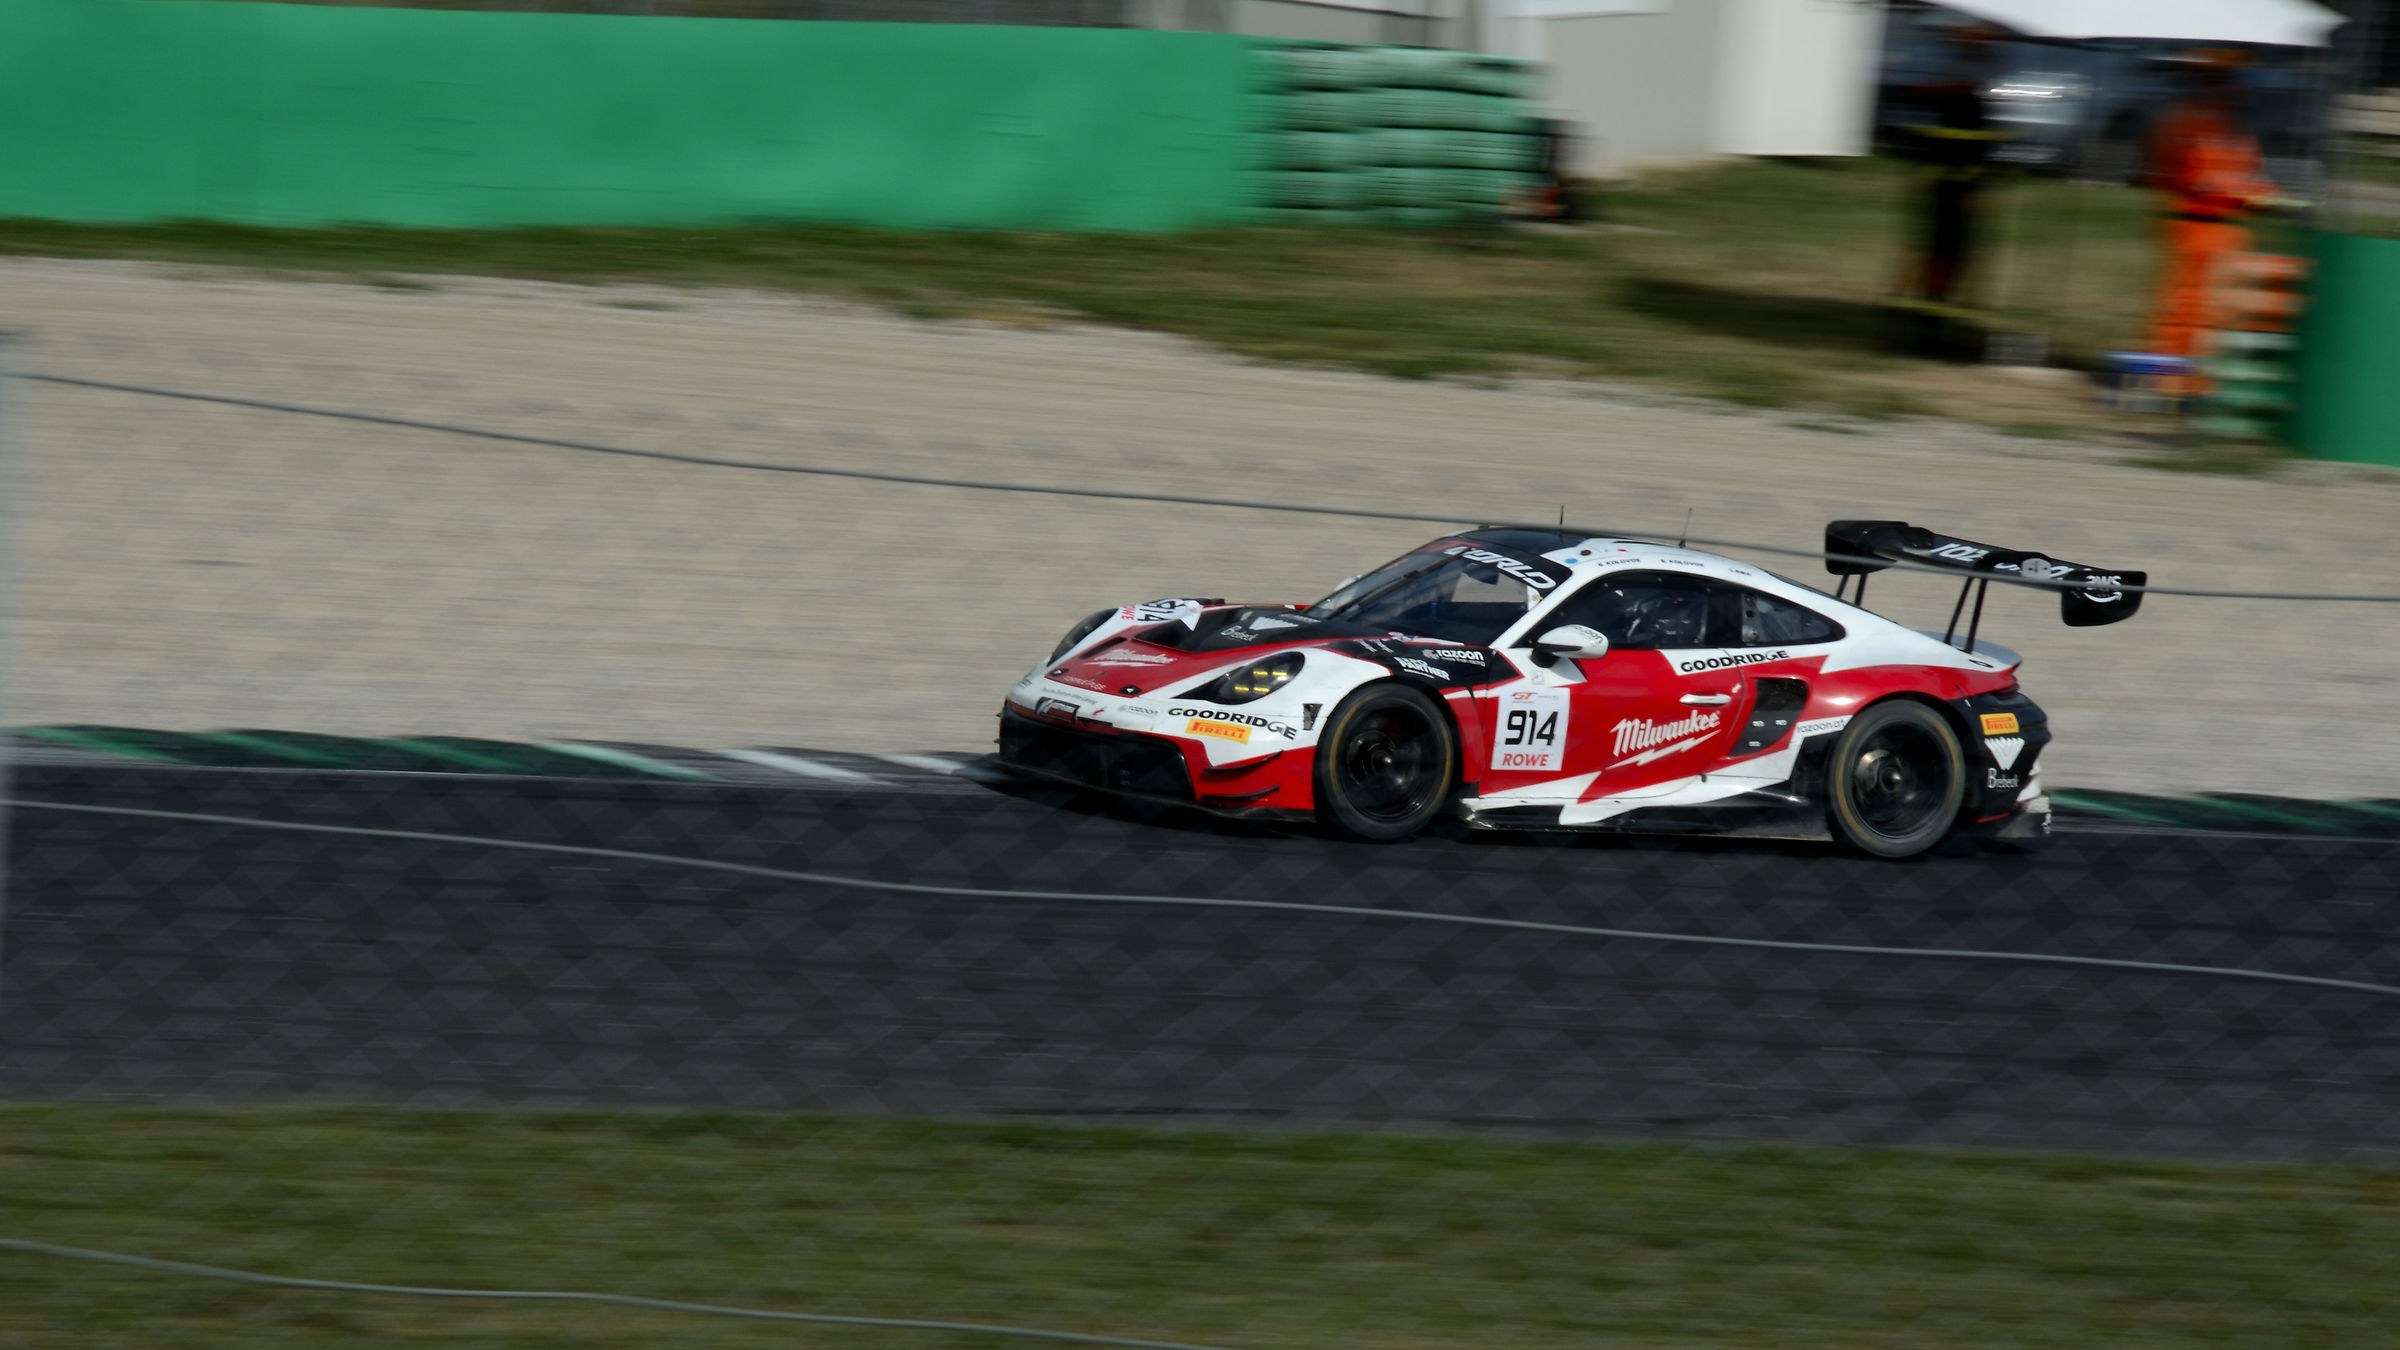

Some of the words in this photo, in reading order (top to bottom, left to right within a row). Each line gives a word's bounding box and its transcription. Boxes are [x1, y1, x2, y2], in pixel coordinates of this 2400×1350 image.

[1437, 649, 1484, 661] razoon
[1681, 650, 1789, 673] GOODRIDGE
[1168, 707, 1297, 740] GOODRIDGE
[1191, 722, 1246, 739] PIRELLI
[1505, 710, 1558, 746] 914
[1610, 709, 1720, 757] Milwaukee
[1502, 753, 1549, 767] ROWE
